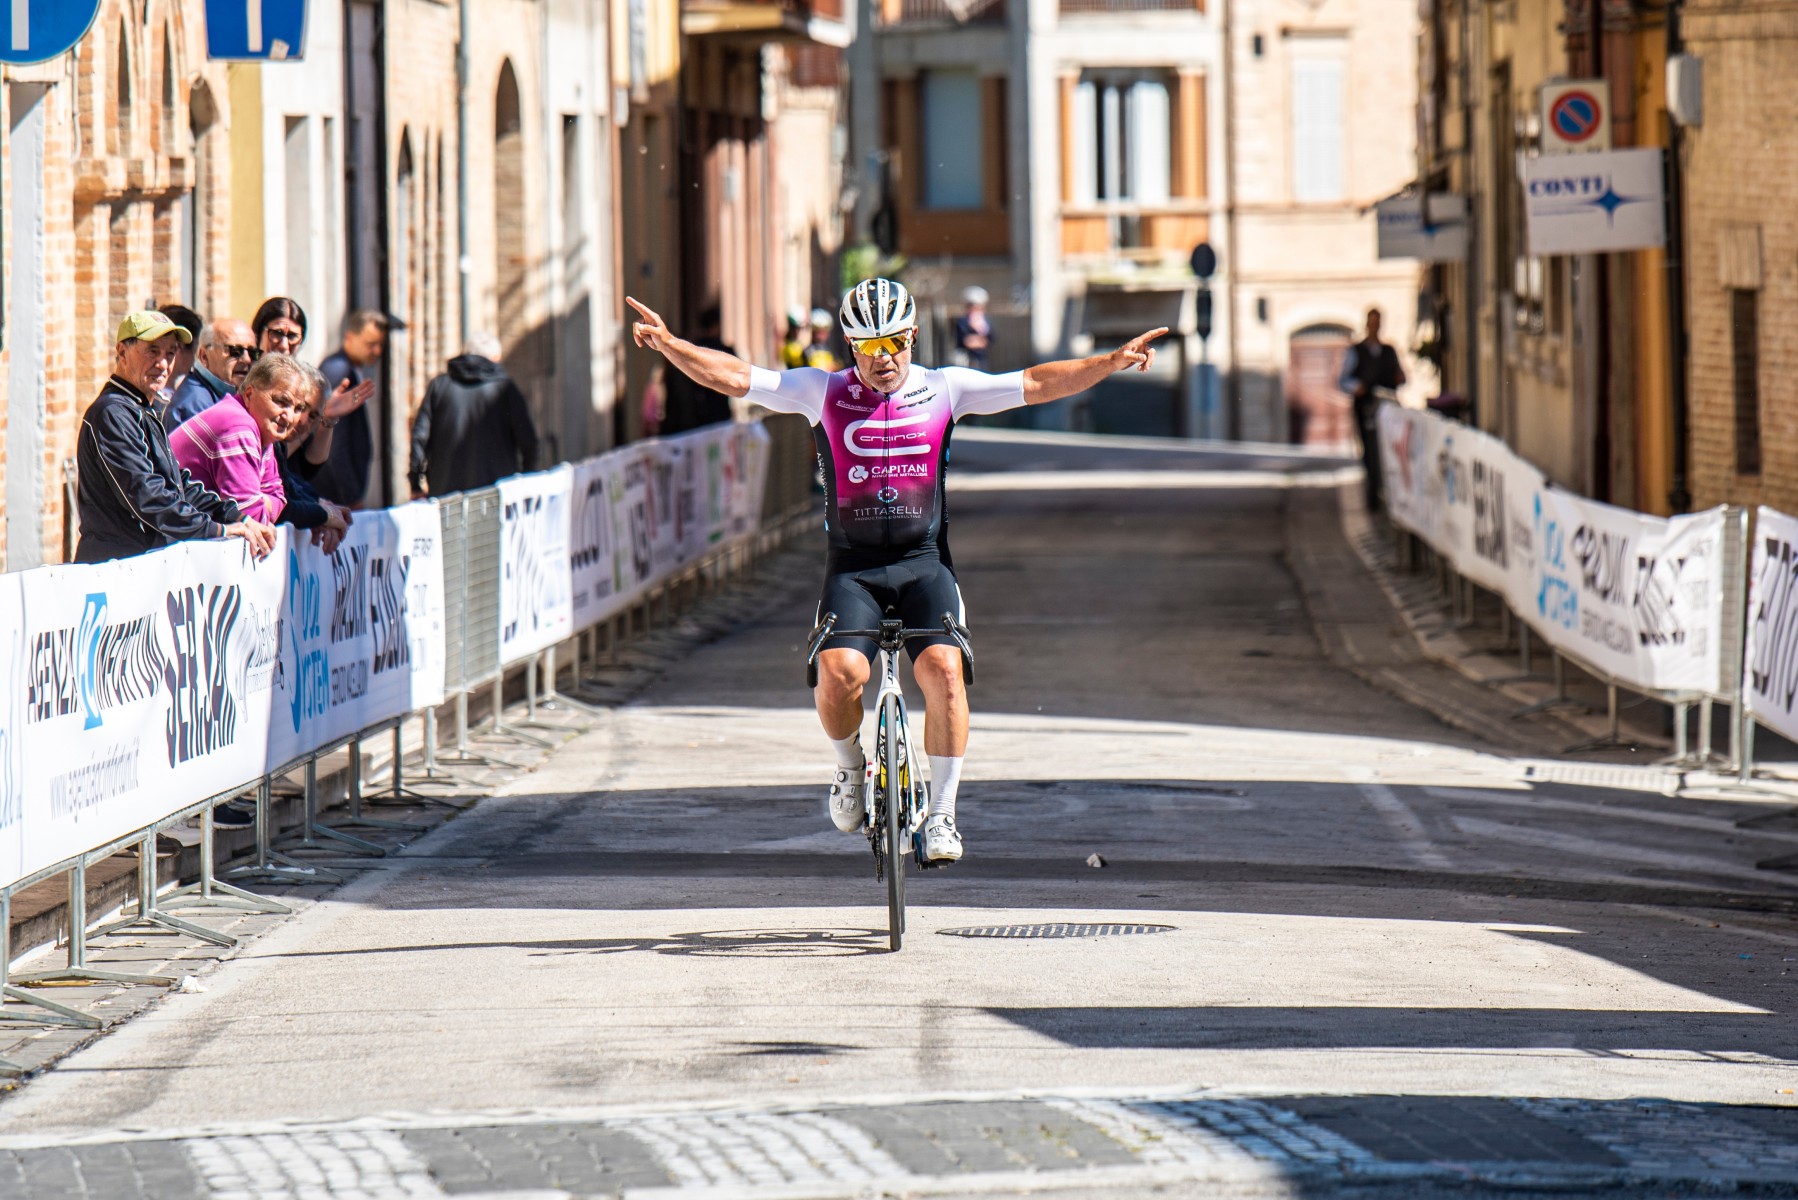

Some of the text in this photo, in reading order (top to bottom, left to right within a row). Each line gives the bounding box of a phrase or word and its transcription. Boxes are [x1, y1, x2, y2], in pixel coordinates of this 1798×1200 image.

[1530, 176, 1602, 196] CONTI
[871, 463, 928, 475] CAPITANI
[853, 506, 922, 517] TITTARELLI
[28, 626, 81, 724] AGENZIA
[96, 611, 166, 711] INFORTUNI
